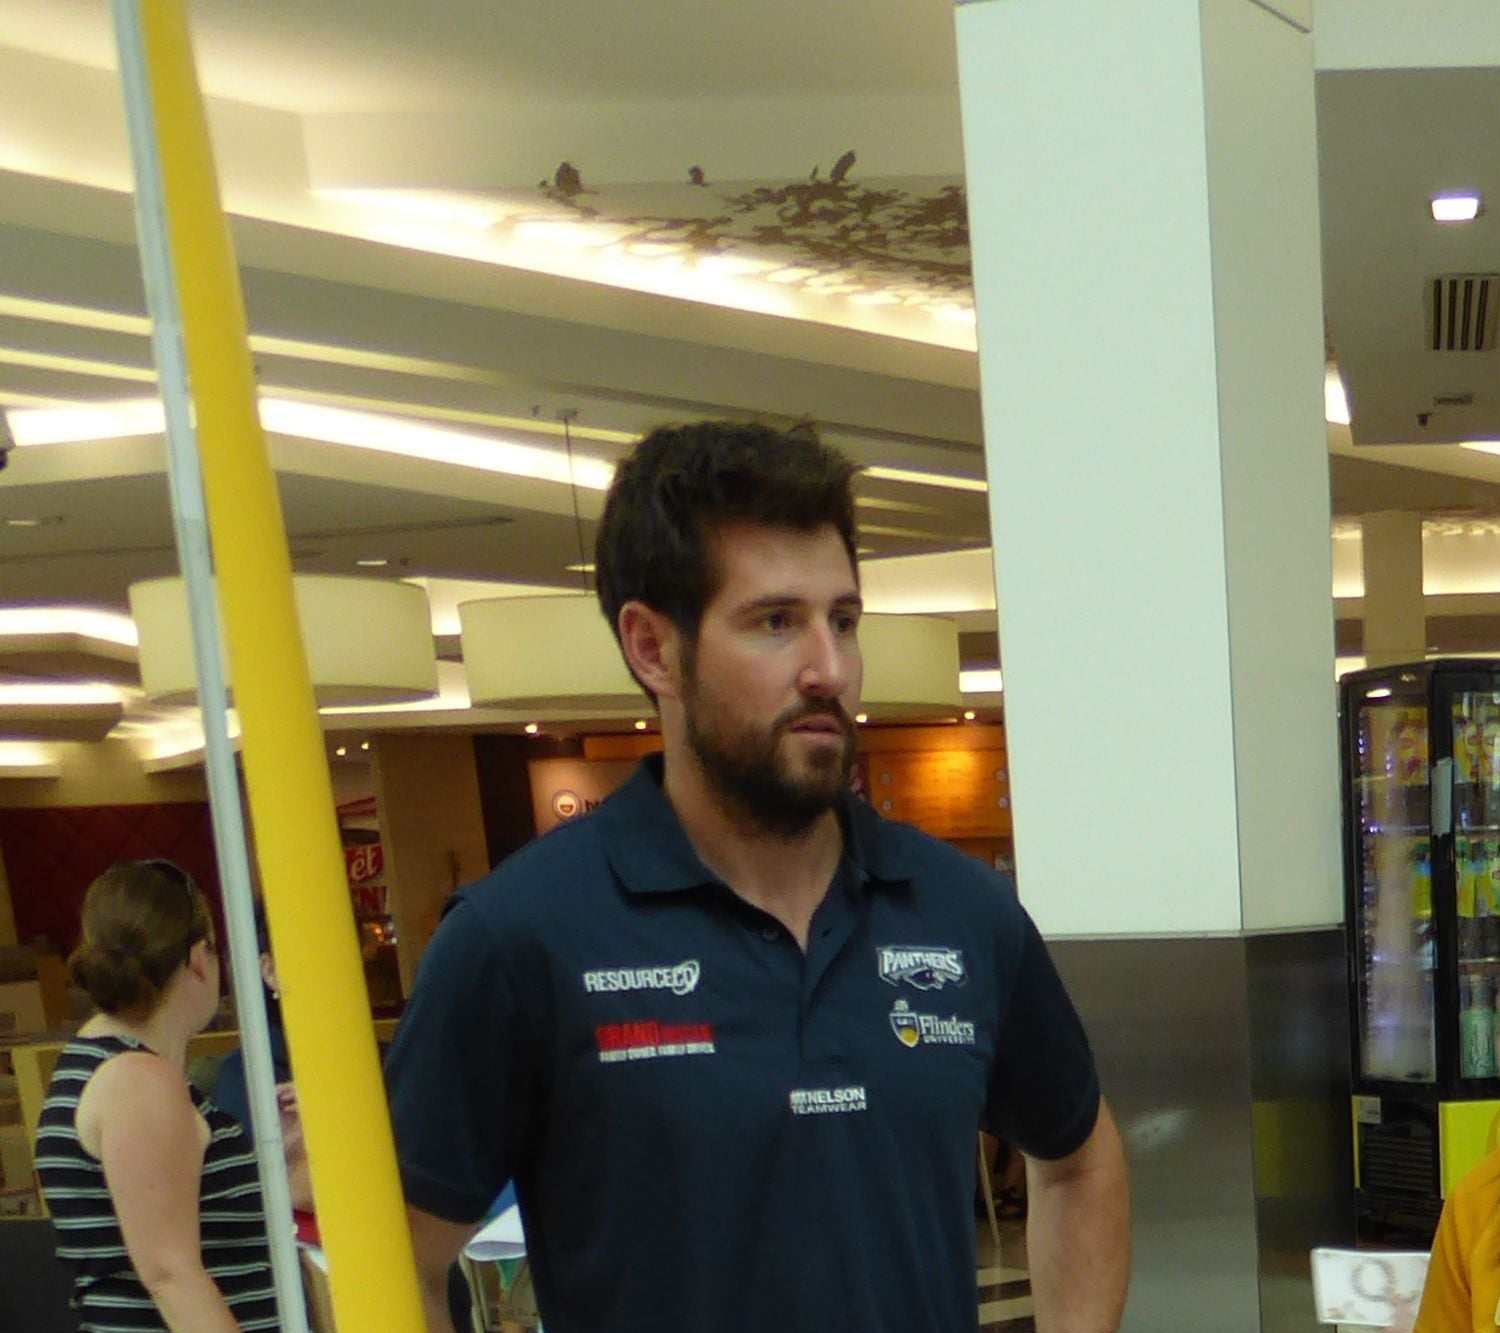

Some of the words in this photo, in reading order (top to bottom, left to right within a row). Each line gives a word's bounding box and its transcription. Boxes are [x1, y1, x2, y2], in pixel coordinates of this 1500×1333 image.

[881, 949, 963, 974] PANTHERS
[584, 960, 700, 994] RESOURCECO
[919, 1014, 975, 1037] Flinders
[791, 1100, 868, 1114] TEAMWEAR
[808, 1087, 865, 1104] NELSON
